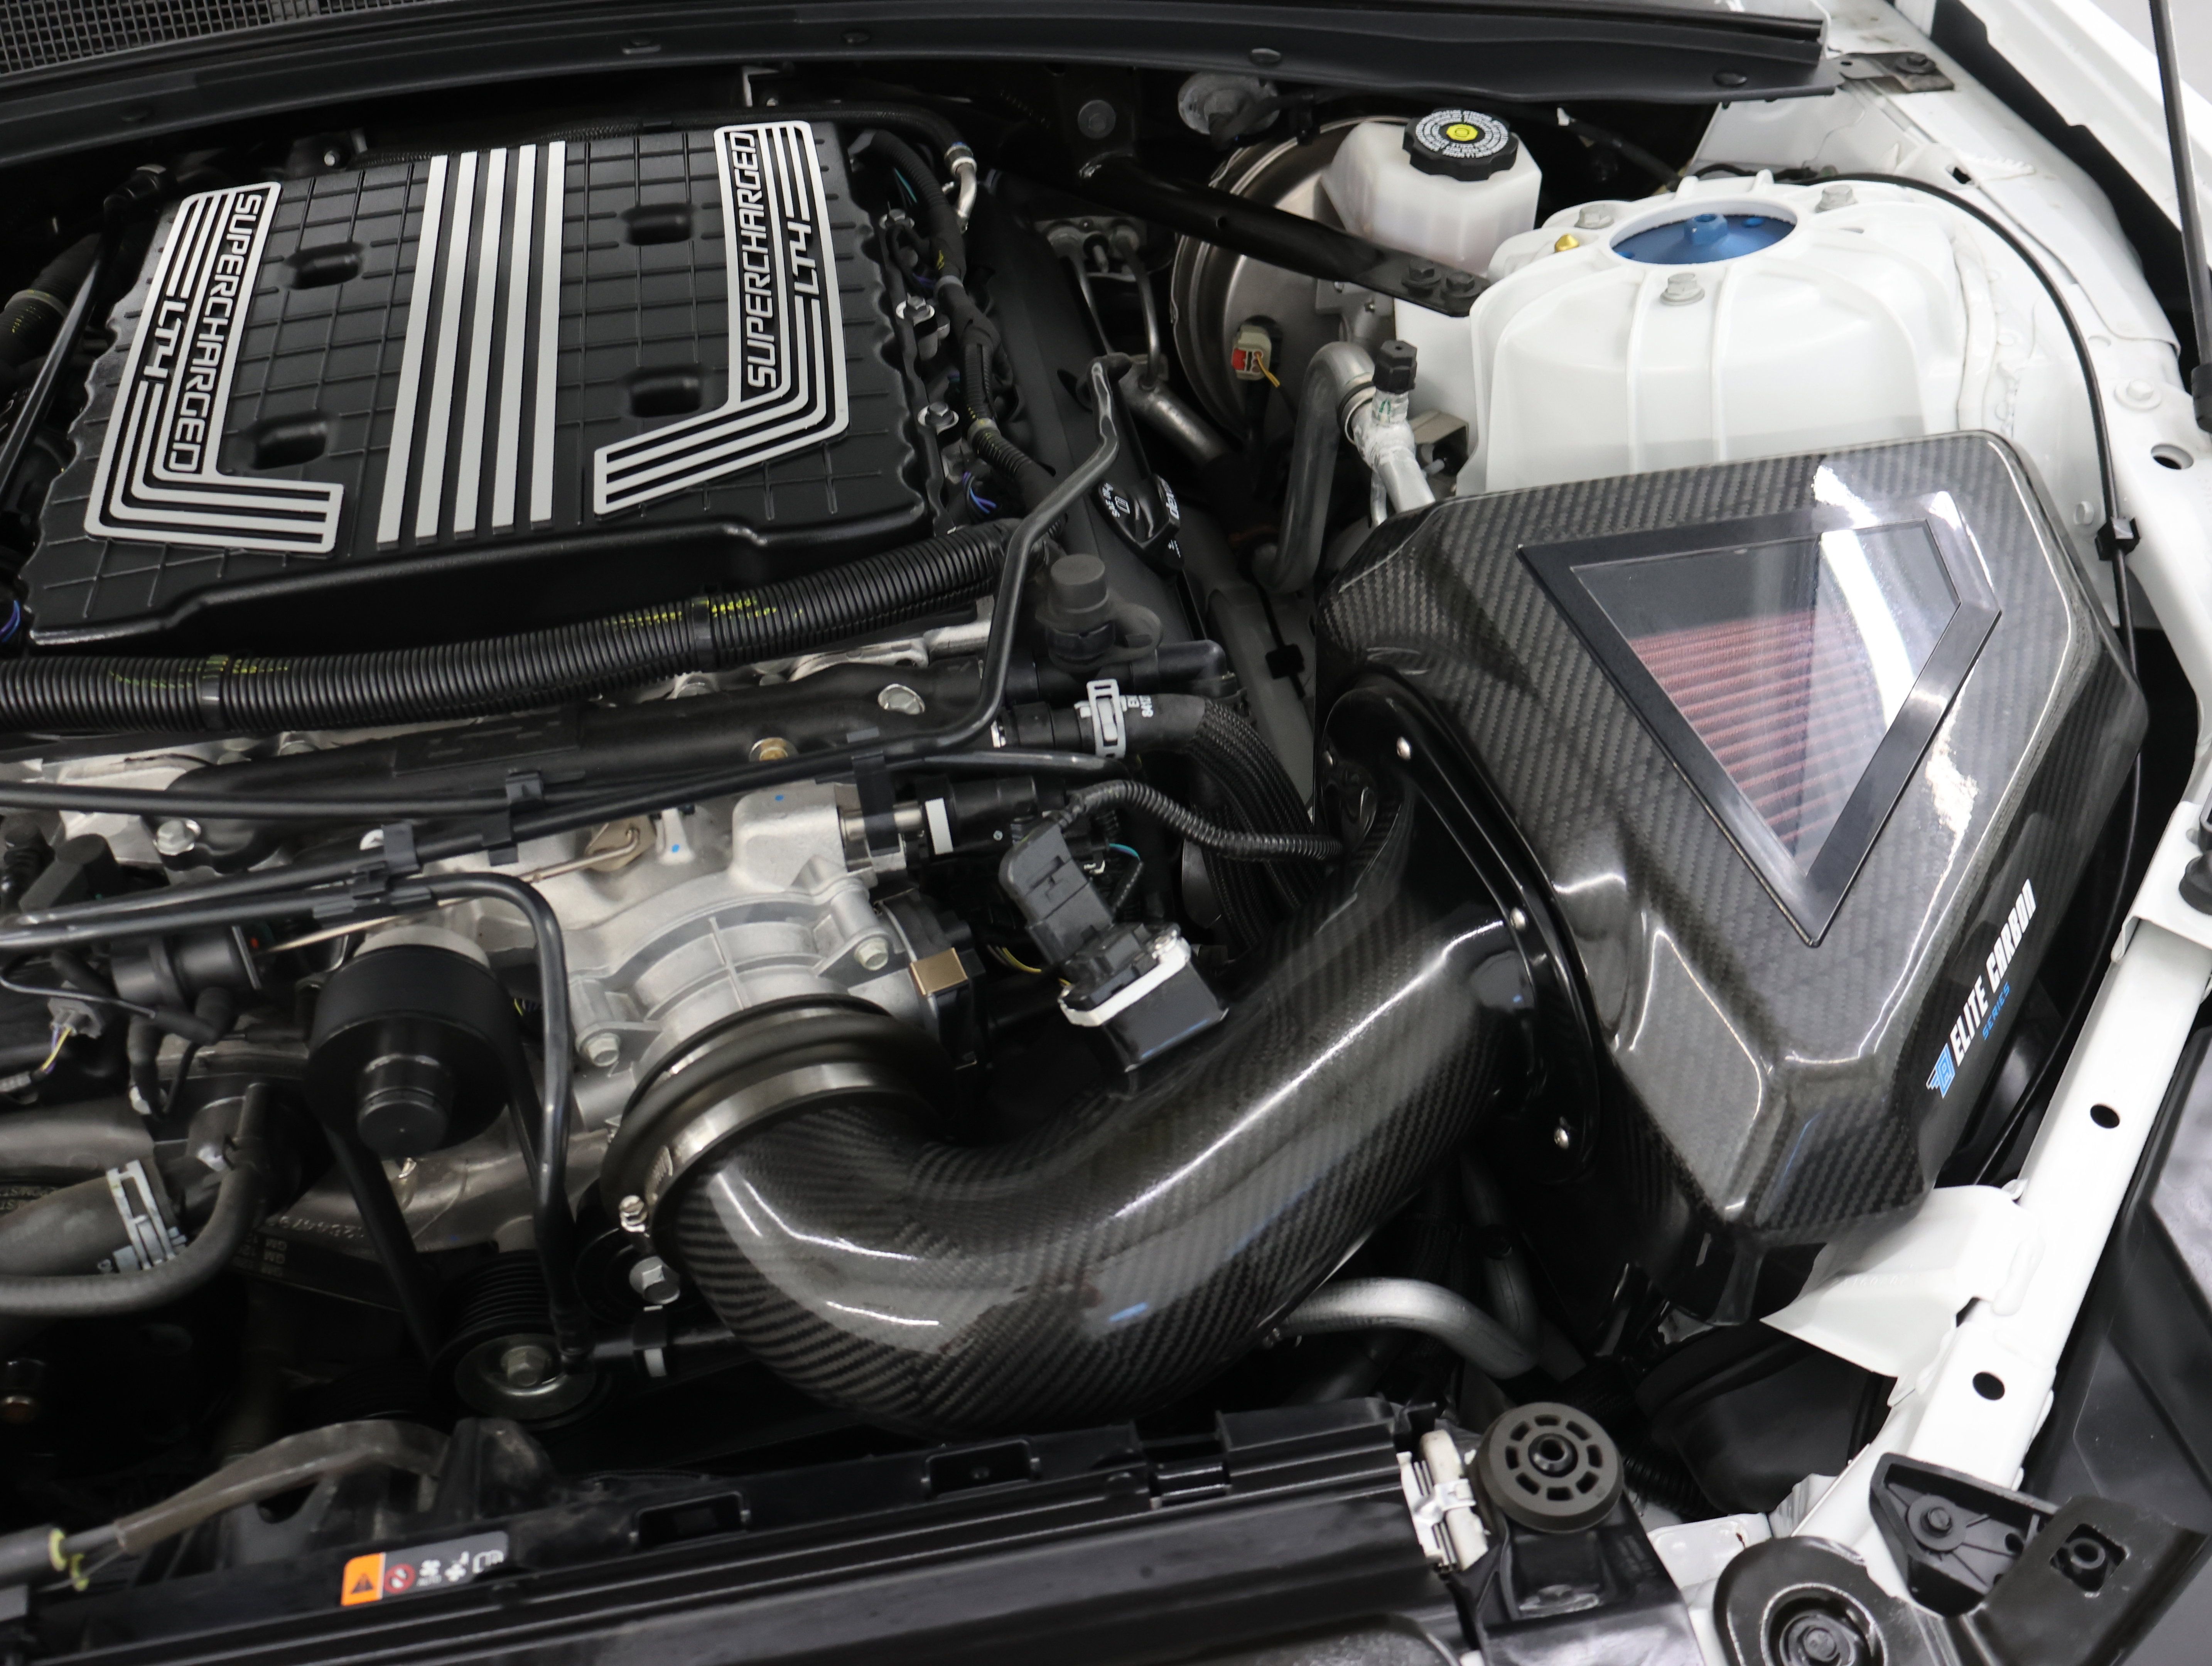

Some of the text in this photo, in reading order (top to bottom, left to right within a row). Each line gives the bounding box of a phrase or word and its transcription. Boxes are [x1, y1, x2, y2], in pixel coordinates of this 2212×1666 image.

[730, 132, 776, 389] SUPERCHARGED
[787, 221, 820, 295] LT4
[143, 300, 186, 379] LT4
[169, 193, 262, 473] SUPERCHARGED
[1950, 878, 2037, 1067] ELITE CARBON
[1982, 981, 2011, 1040] SERIES
